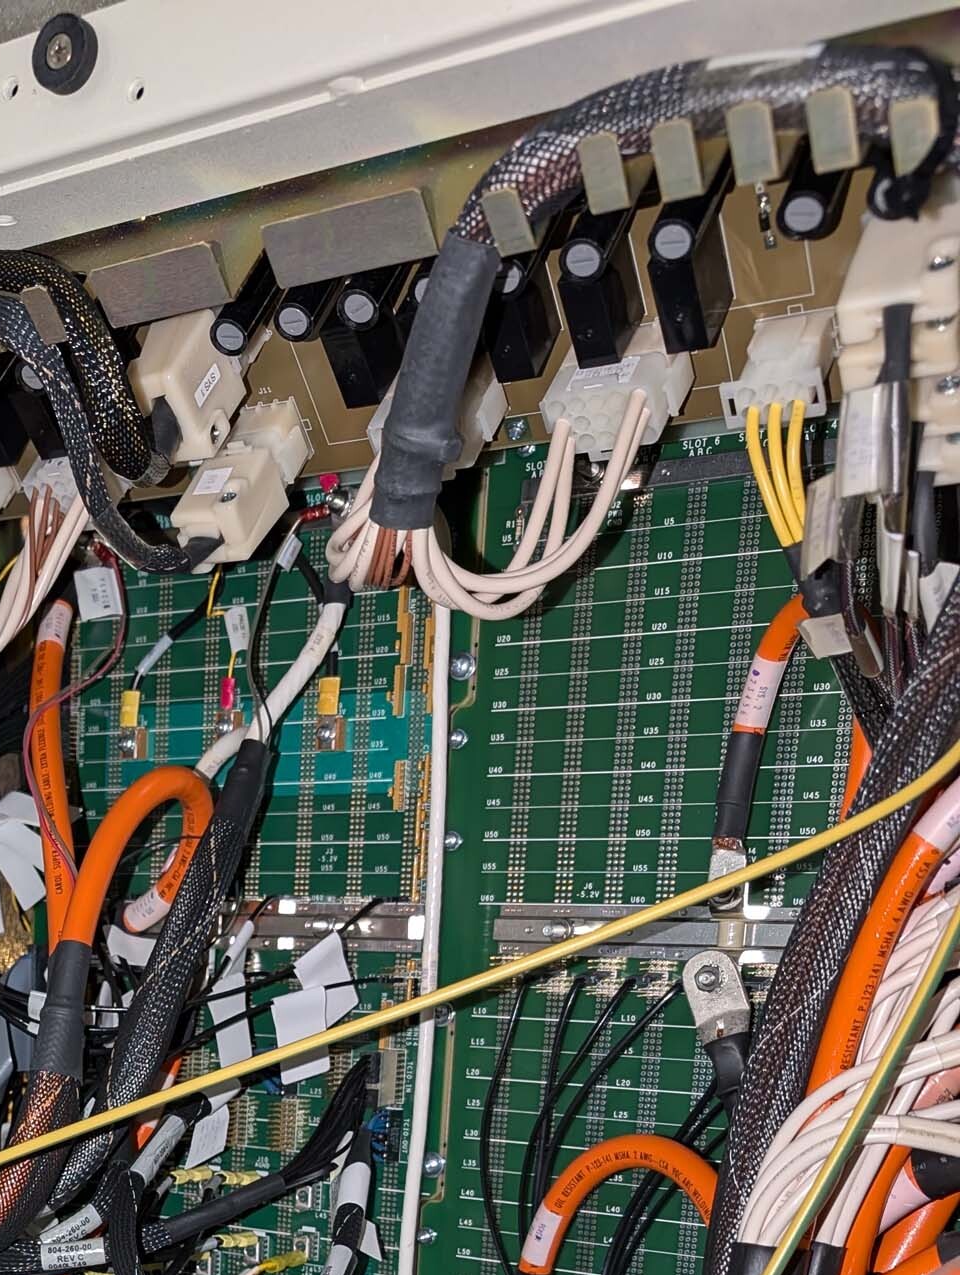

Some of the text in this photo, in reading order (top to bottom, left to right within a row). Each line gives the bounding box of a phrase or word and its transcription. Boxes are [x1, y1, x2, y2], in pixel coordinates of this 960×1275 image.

[205, 372, 217, 392] SYS
[682, 437, 720, 451] SLOT 6
[497, 635, 511, 643] U20
[495, 668, 509, 676] U25
[813, 683, 830, 691] U30
[492, 701, 507, 709] U30
[644, 727, 659, 735] U35
[638, 795, 653, 803] U45
[636, 829, 651, 837] U50
[402, 1119, 410, 1153] TCIO-OUT
[48, 1244, 92, 1254] 804-260-00
